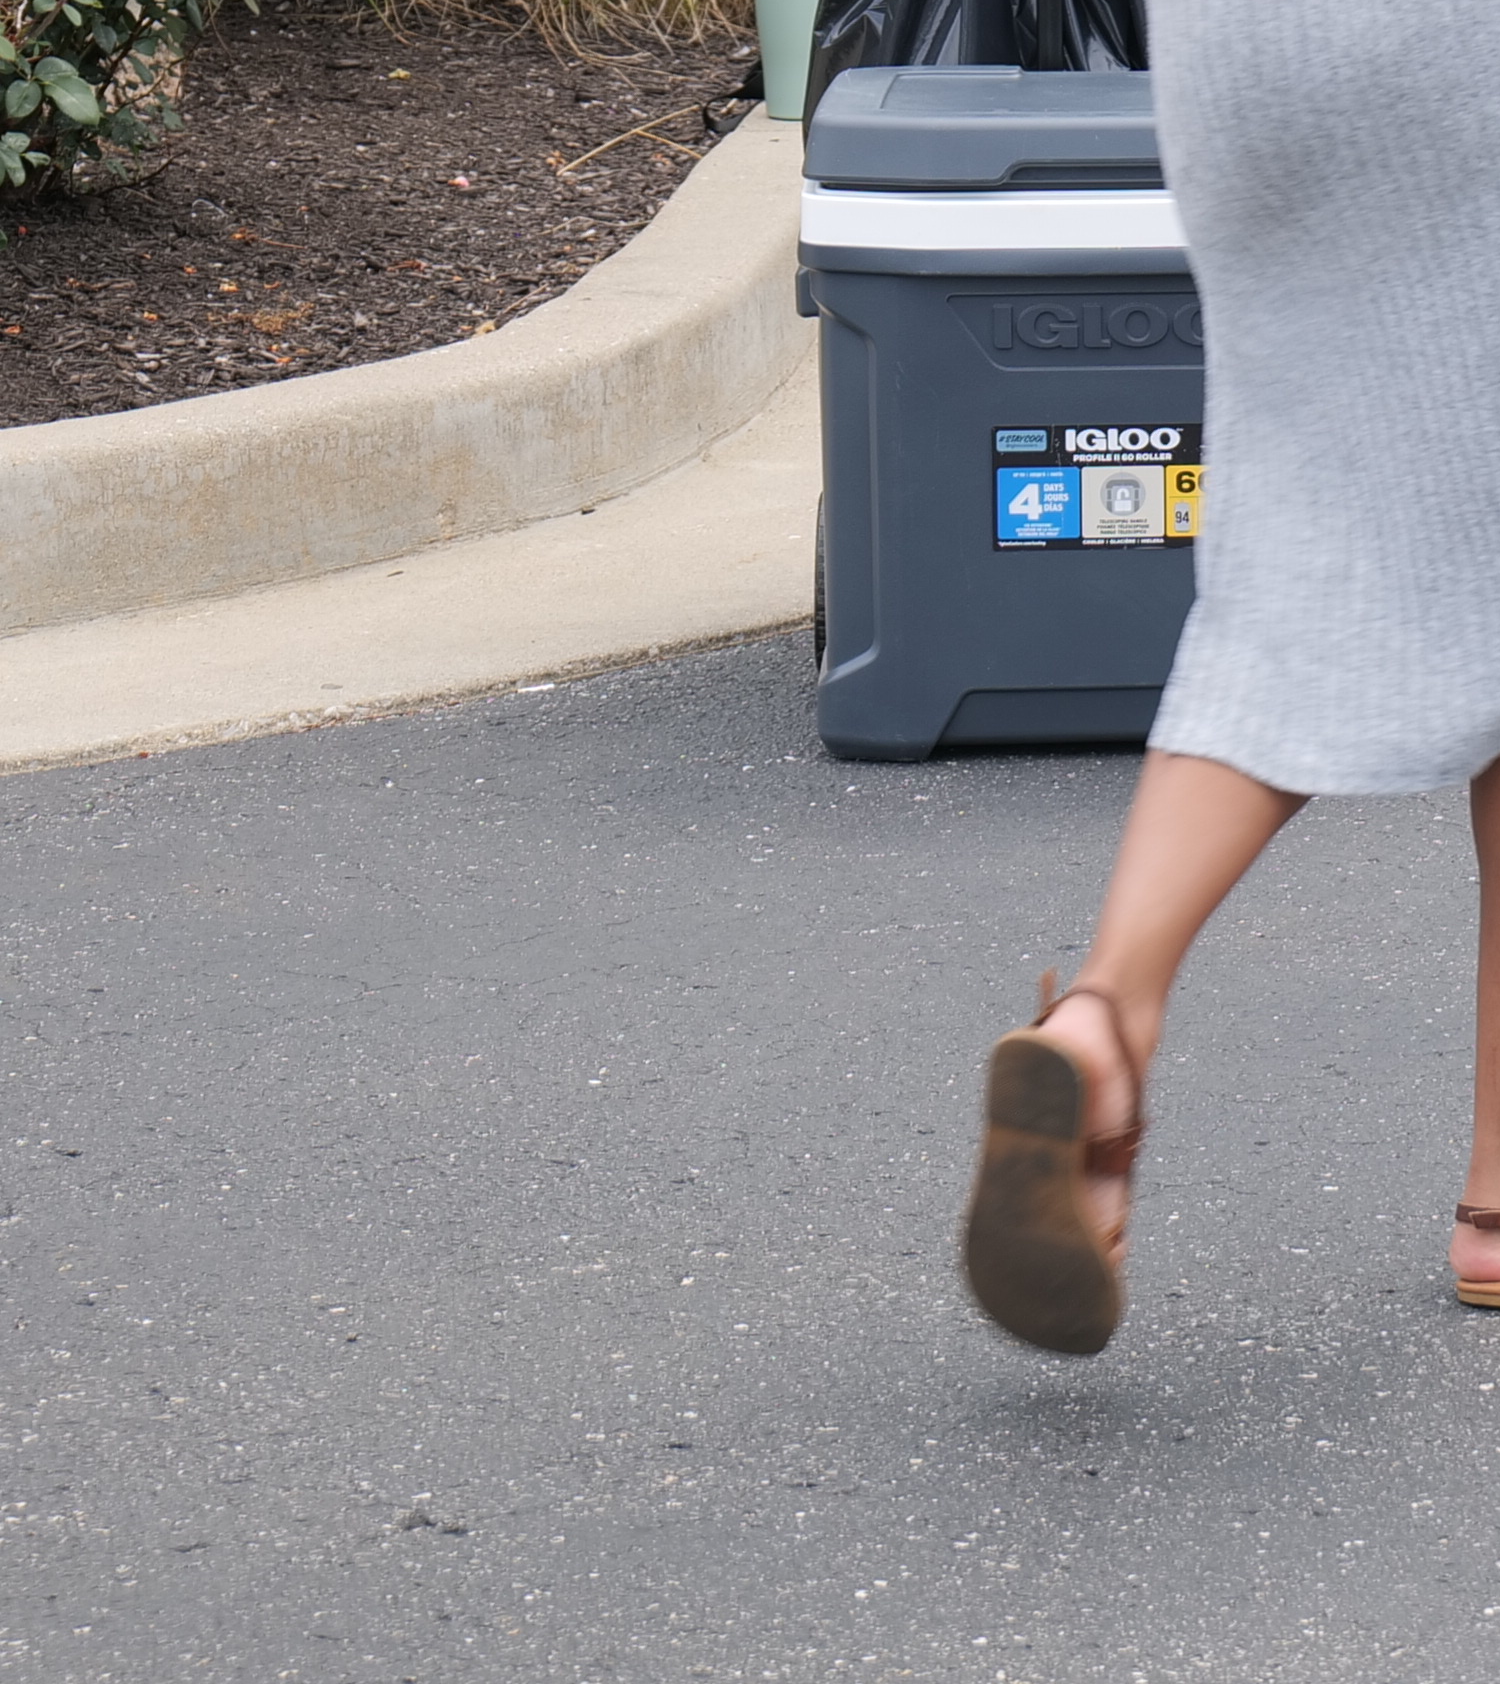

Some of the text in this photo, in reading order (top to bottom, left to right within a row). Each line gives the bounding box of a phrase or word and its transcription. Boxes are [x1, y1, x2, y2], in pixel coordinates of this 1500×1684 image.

[1065, 427, 1181, 452] IGLOO
[1073, 454, 1111, 462] PROFILE
[1121, 453, 1135, 461] 60
[1135, 452, 1173, 461] ROLLER
[1043, 483, 1065, 492] DAYS
[1008, 482, 1043, 521] 4
[1043, 493, 1069, 502] JOURS
[1175, 510, 1190, 524] 94
